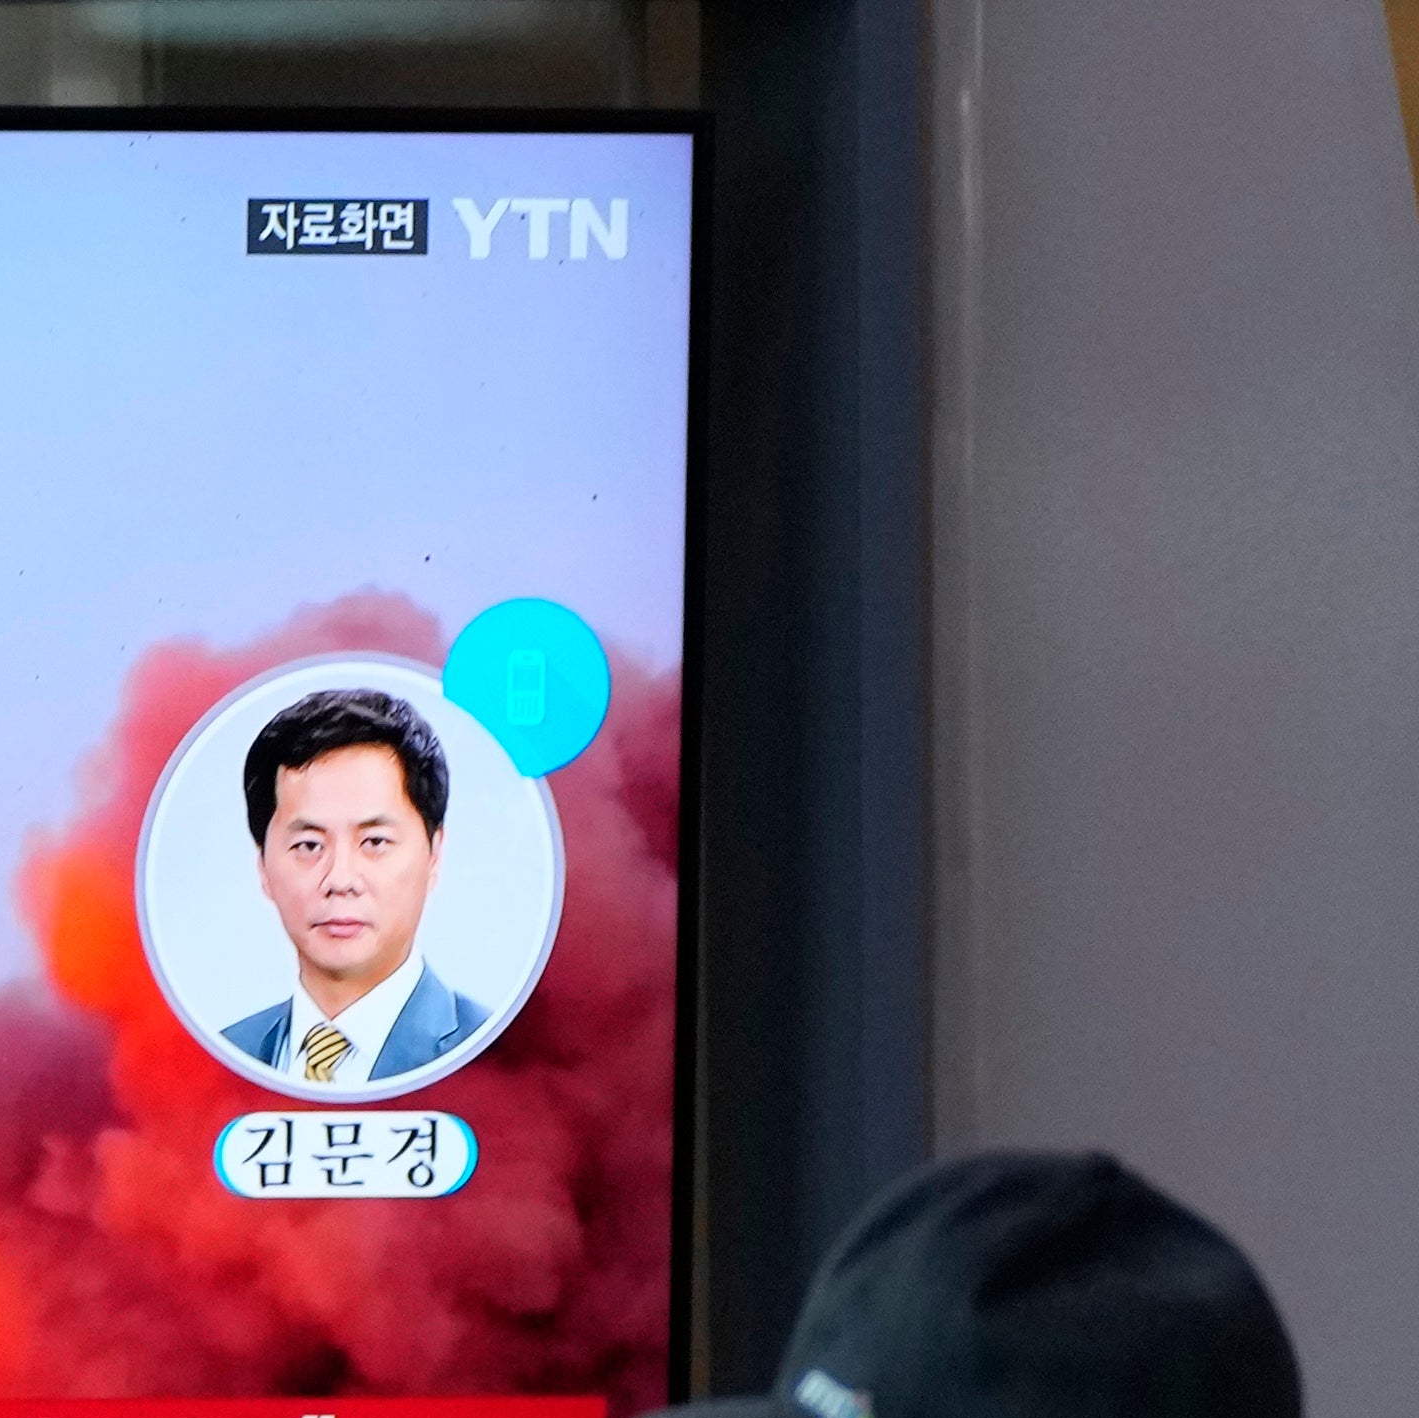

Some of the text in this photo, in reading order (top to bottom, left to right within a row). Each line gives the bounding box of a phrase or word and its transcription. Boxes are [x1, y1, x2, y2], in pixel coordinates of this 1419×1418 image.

[259, 202, 415, 250] 자료화면
[452, 198, 630, 260] YTN
[241, 1118, 441, 1189] 김문경
